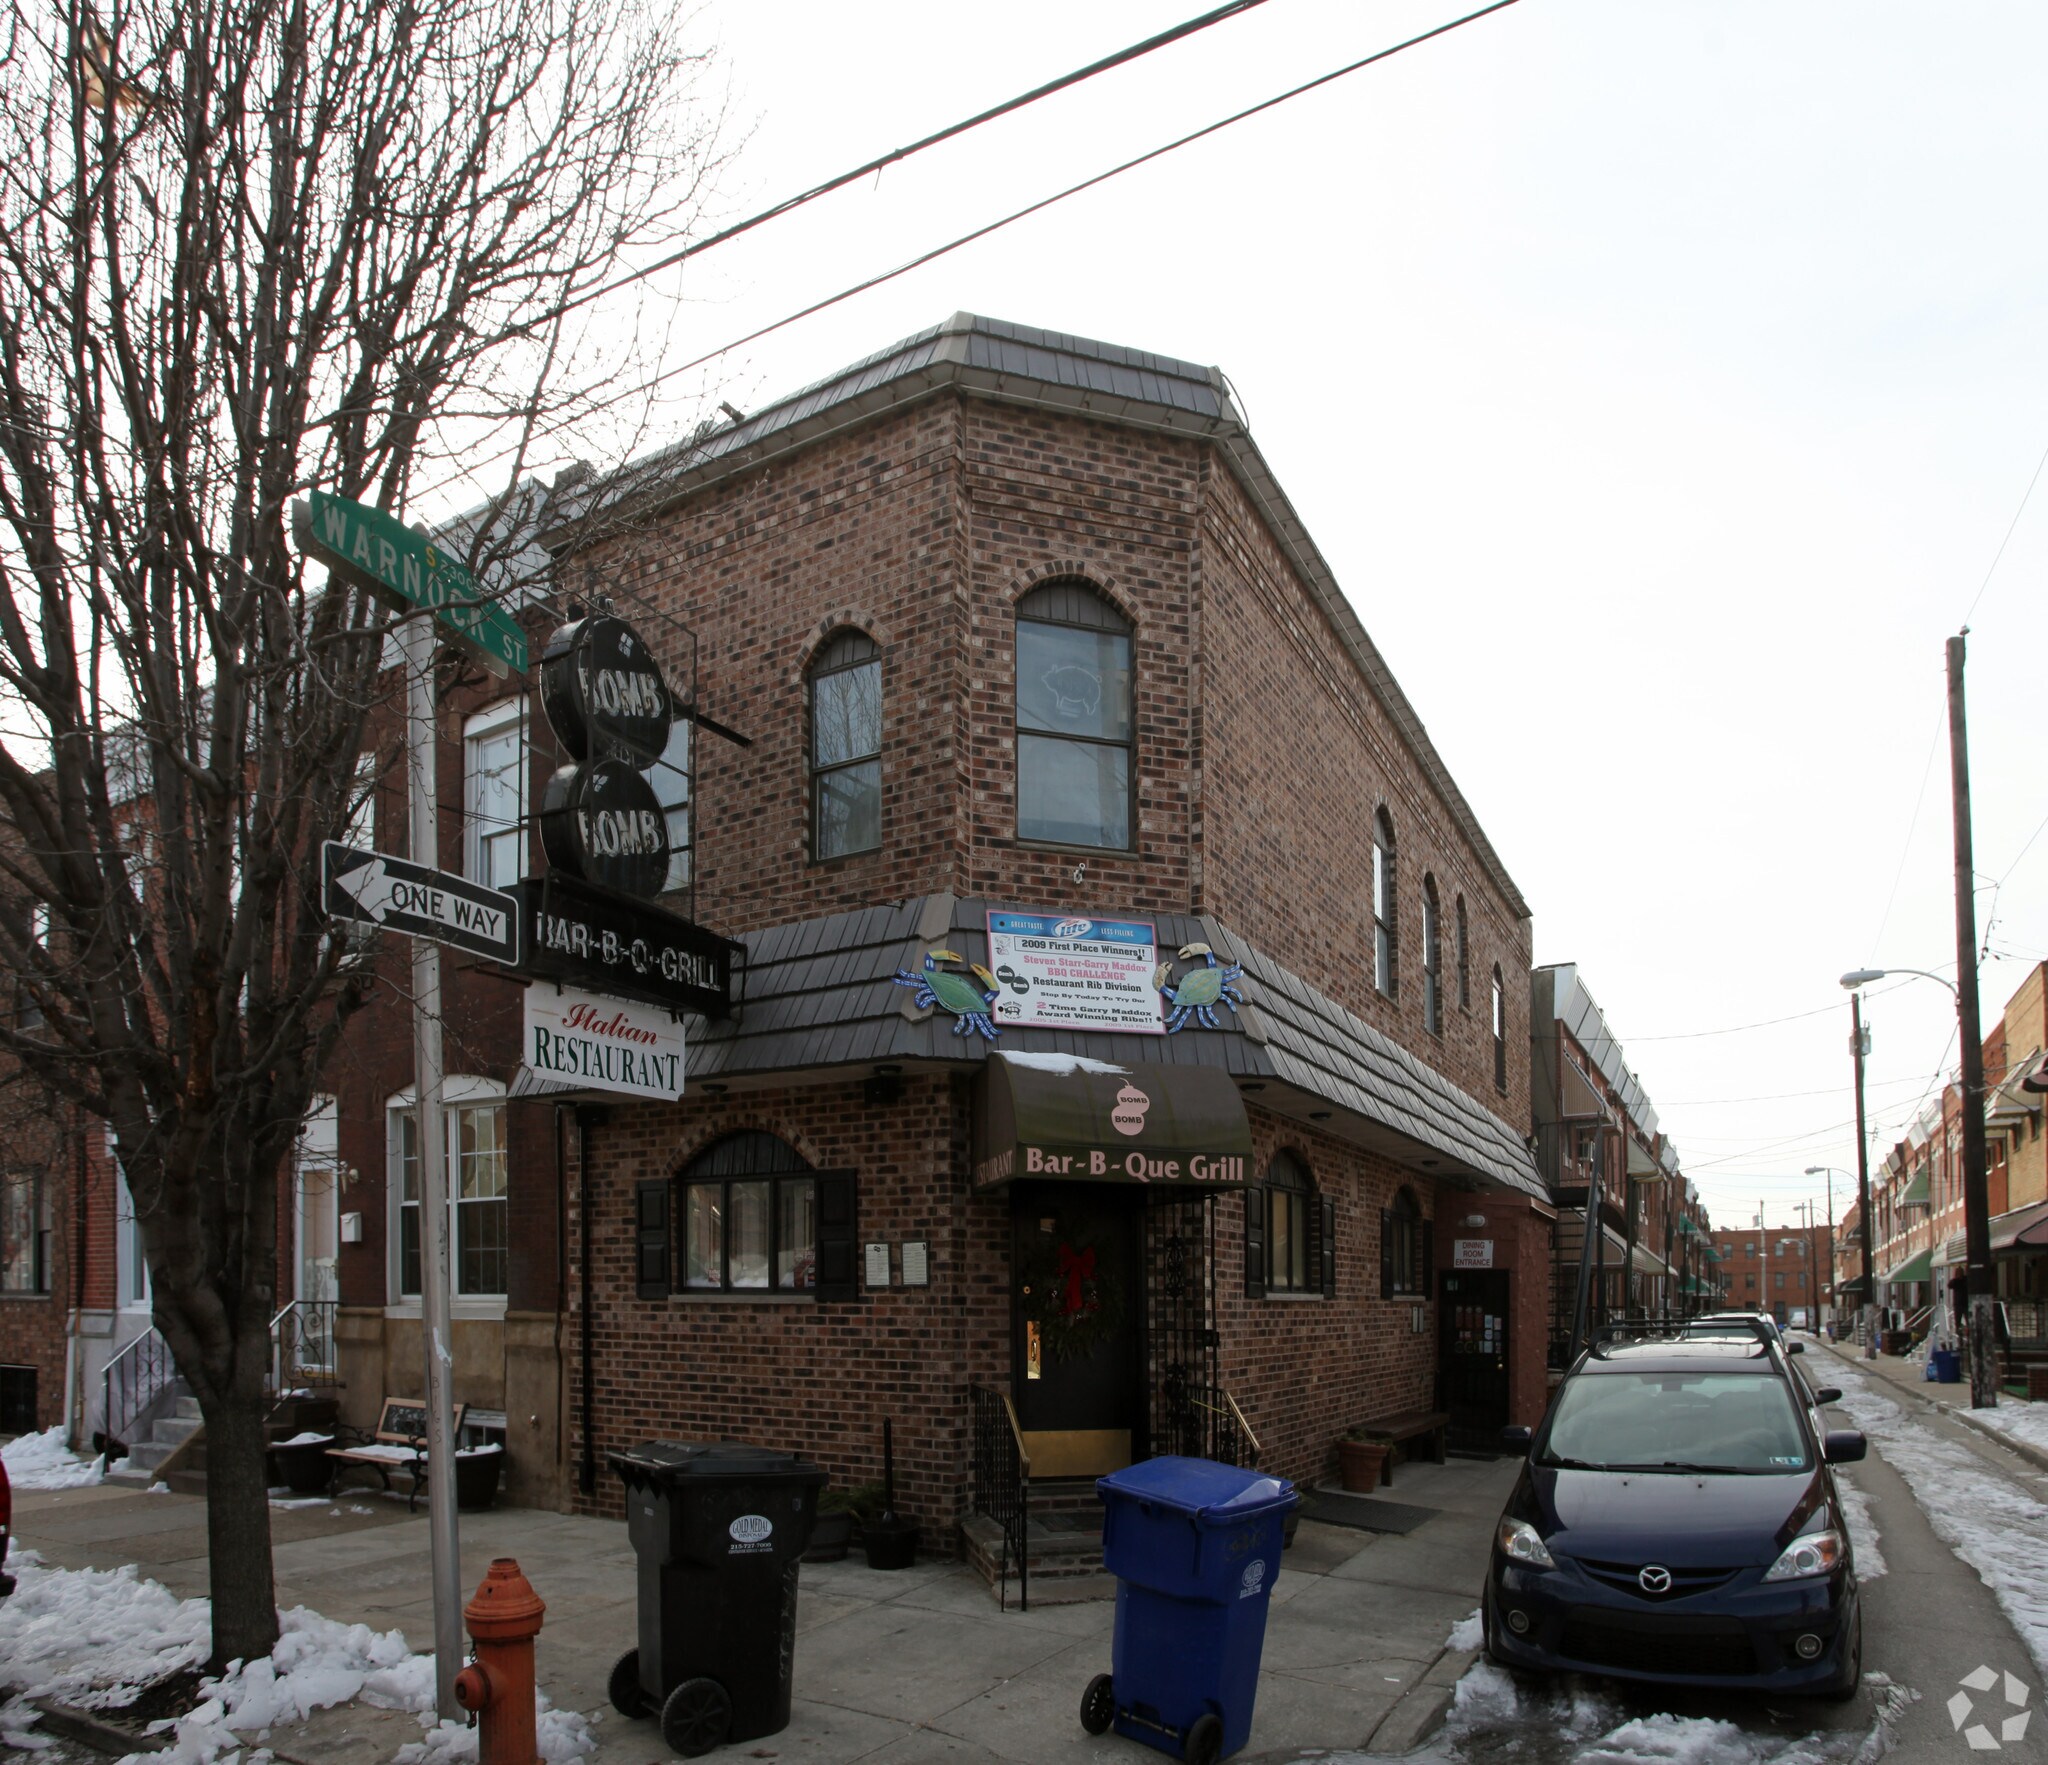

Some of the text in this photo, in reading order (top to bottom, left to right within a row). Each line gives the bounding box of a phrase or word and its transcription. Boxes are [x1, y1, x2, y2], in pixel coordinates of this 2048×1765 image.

[426, 546, 473, 592] S 2300
[323, 499, 523, 666] WARNOCK ST
[578, 668, 662, 719] BOMB
[578, 809, 662, 858] BOMB
[391, 882, 499, 937] ONE WAY
[1022, 939, 1145, 957] 2009 First Place Winners!!
[1024, 955, 1147, 973] Steven Starr-Garry Maddox
[1048, 967, 1126, 980] BBQ CHALLENGE
[1033, 976, 1142, 992] Restaurant Rib Division
[1036, 1002, 1047, 1010] 2
[1080, 1006, 1108, 1014] Garry
[1112, 1008, 1152, 1017] Maddox
[1037, 1010, 1071, 1018] Award
[1074, 1013, 1118, 1022] Winning
[562, 1003, 658, 1045] Italian
[533, 1026, 680, 1092] RESTAURANT
[1120, 1096, 1148, 1104] BOMB
[1114, 1115, 1142, 1124] BOMB
[1189, 1155, 1244, 1182] Grill
[1462, 1241, 1485, 1249] DINING
[1455, 1258, 1491, 1267] ENTRANCE
[1463, 1250, 1484, 1258] ROOM
[733, 1518, 769, 1533] GOLD MEDAL
